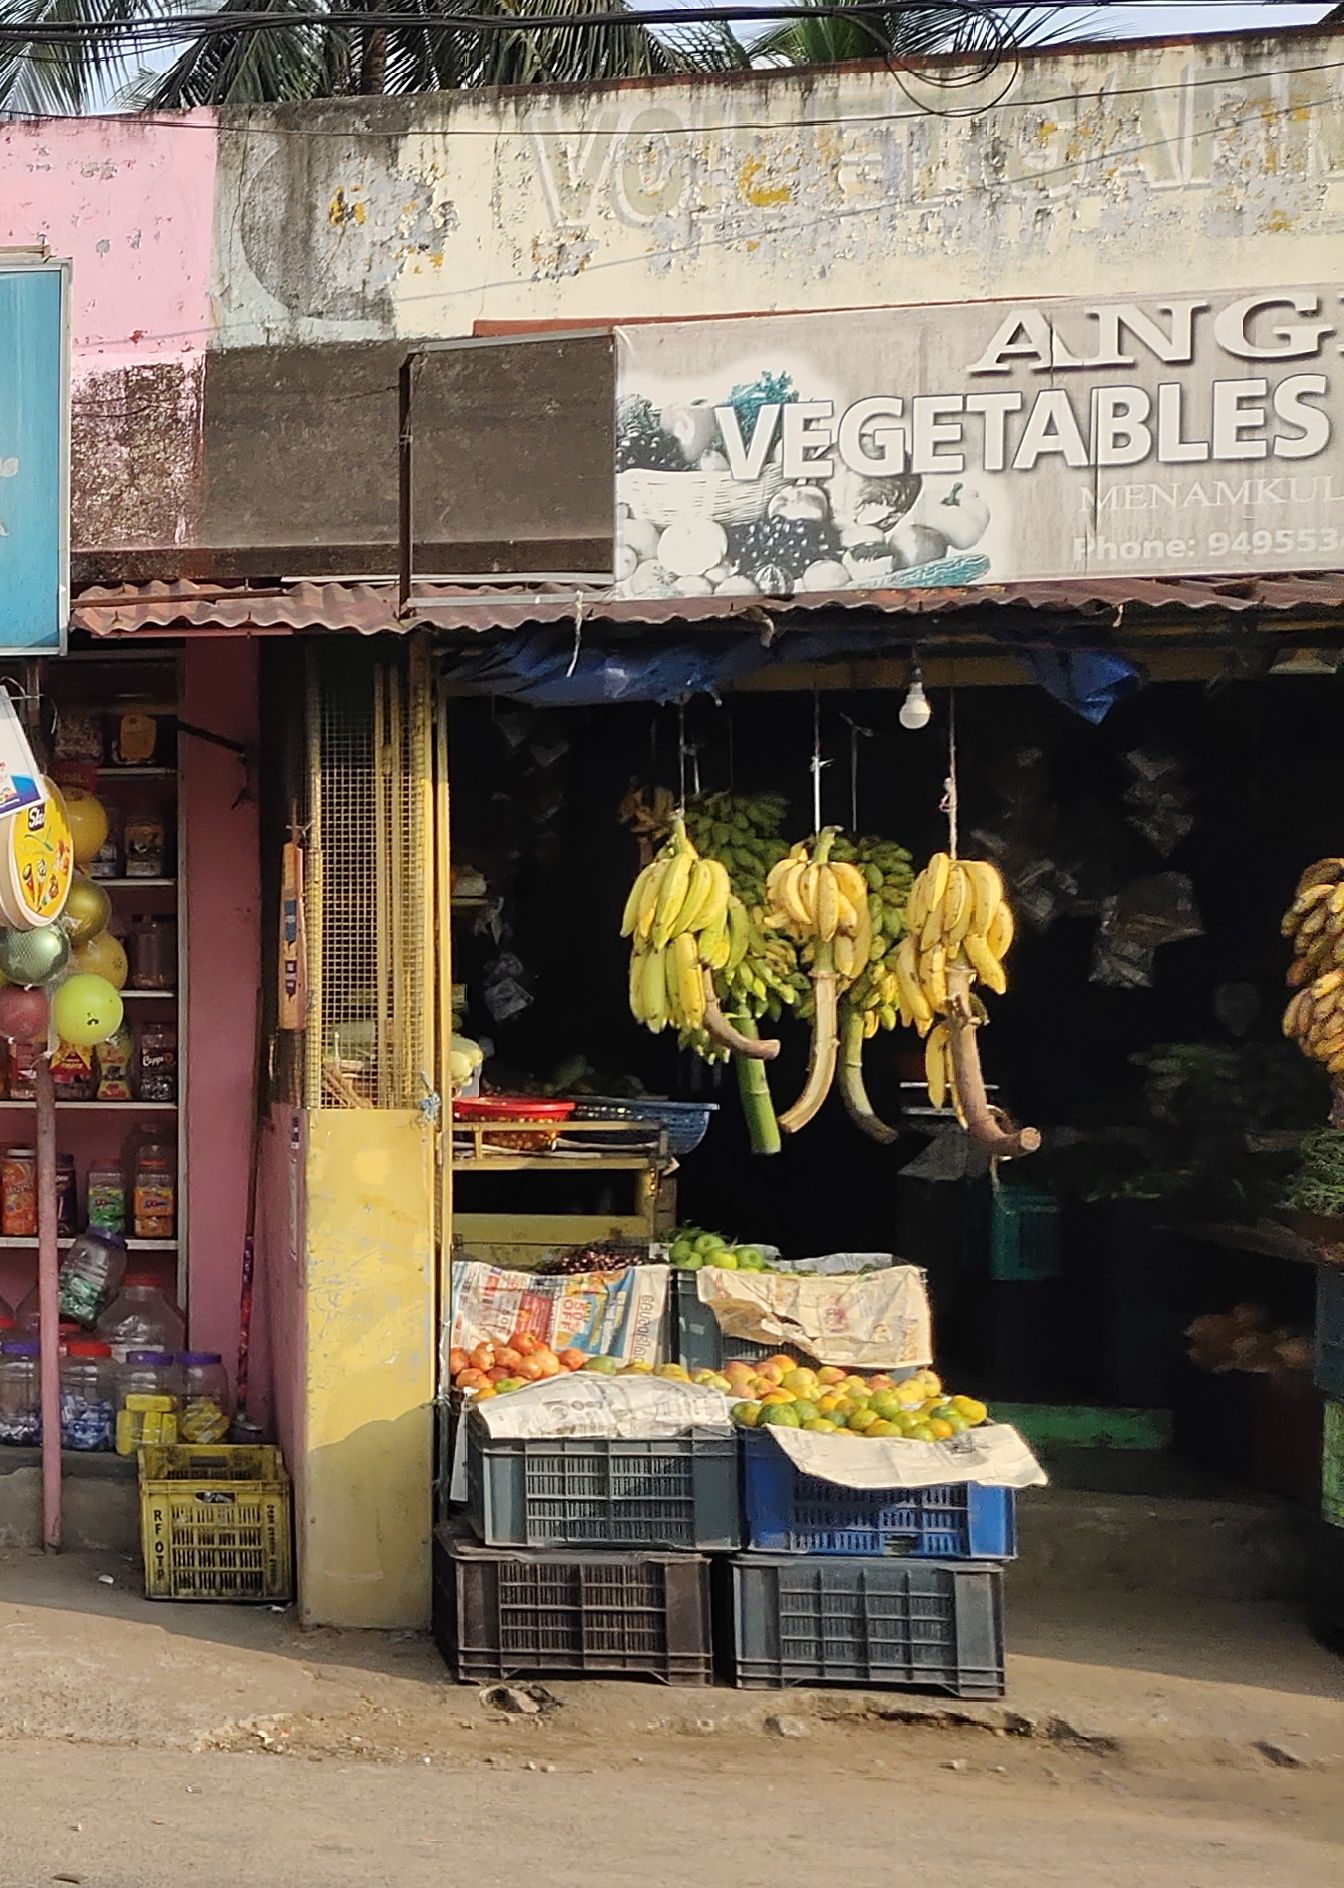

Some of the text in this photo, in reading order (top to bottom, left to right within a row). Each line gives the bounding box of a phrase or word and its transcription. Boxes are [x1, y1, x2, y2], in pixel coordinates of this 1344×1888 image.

[968, 291, 1344, 374] ANG
[716, 373, 1333, 483] VEGETABLES
[1072, 529, 1344, 561] Phone: 949553
